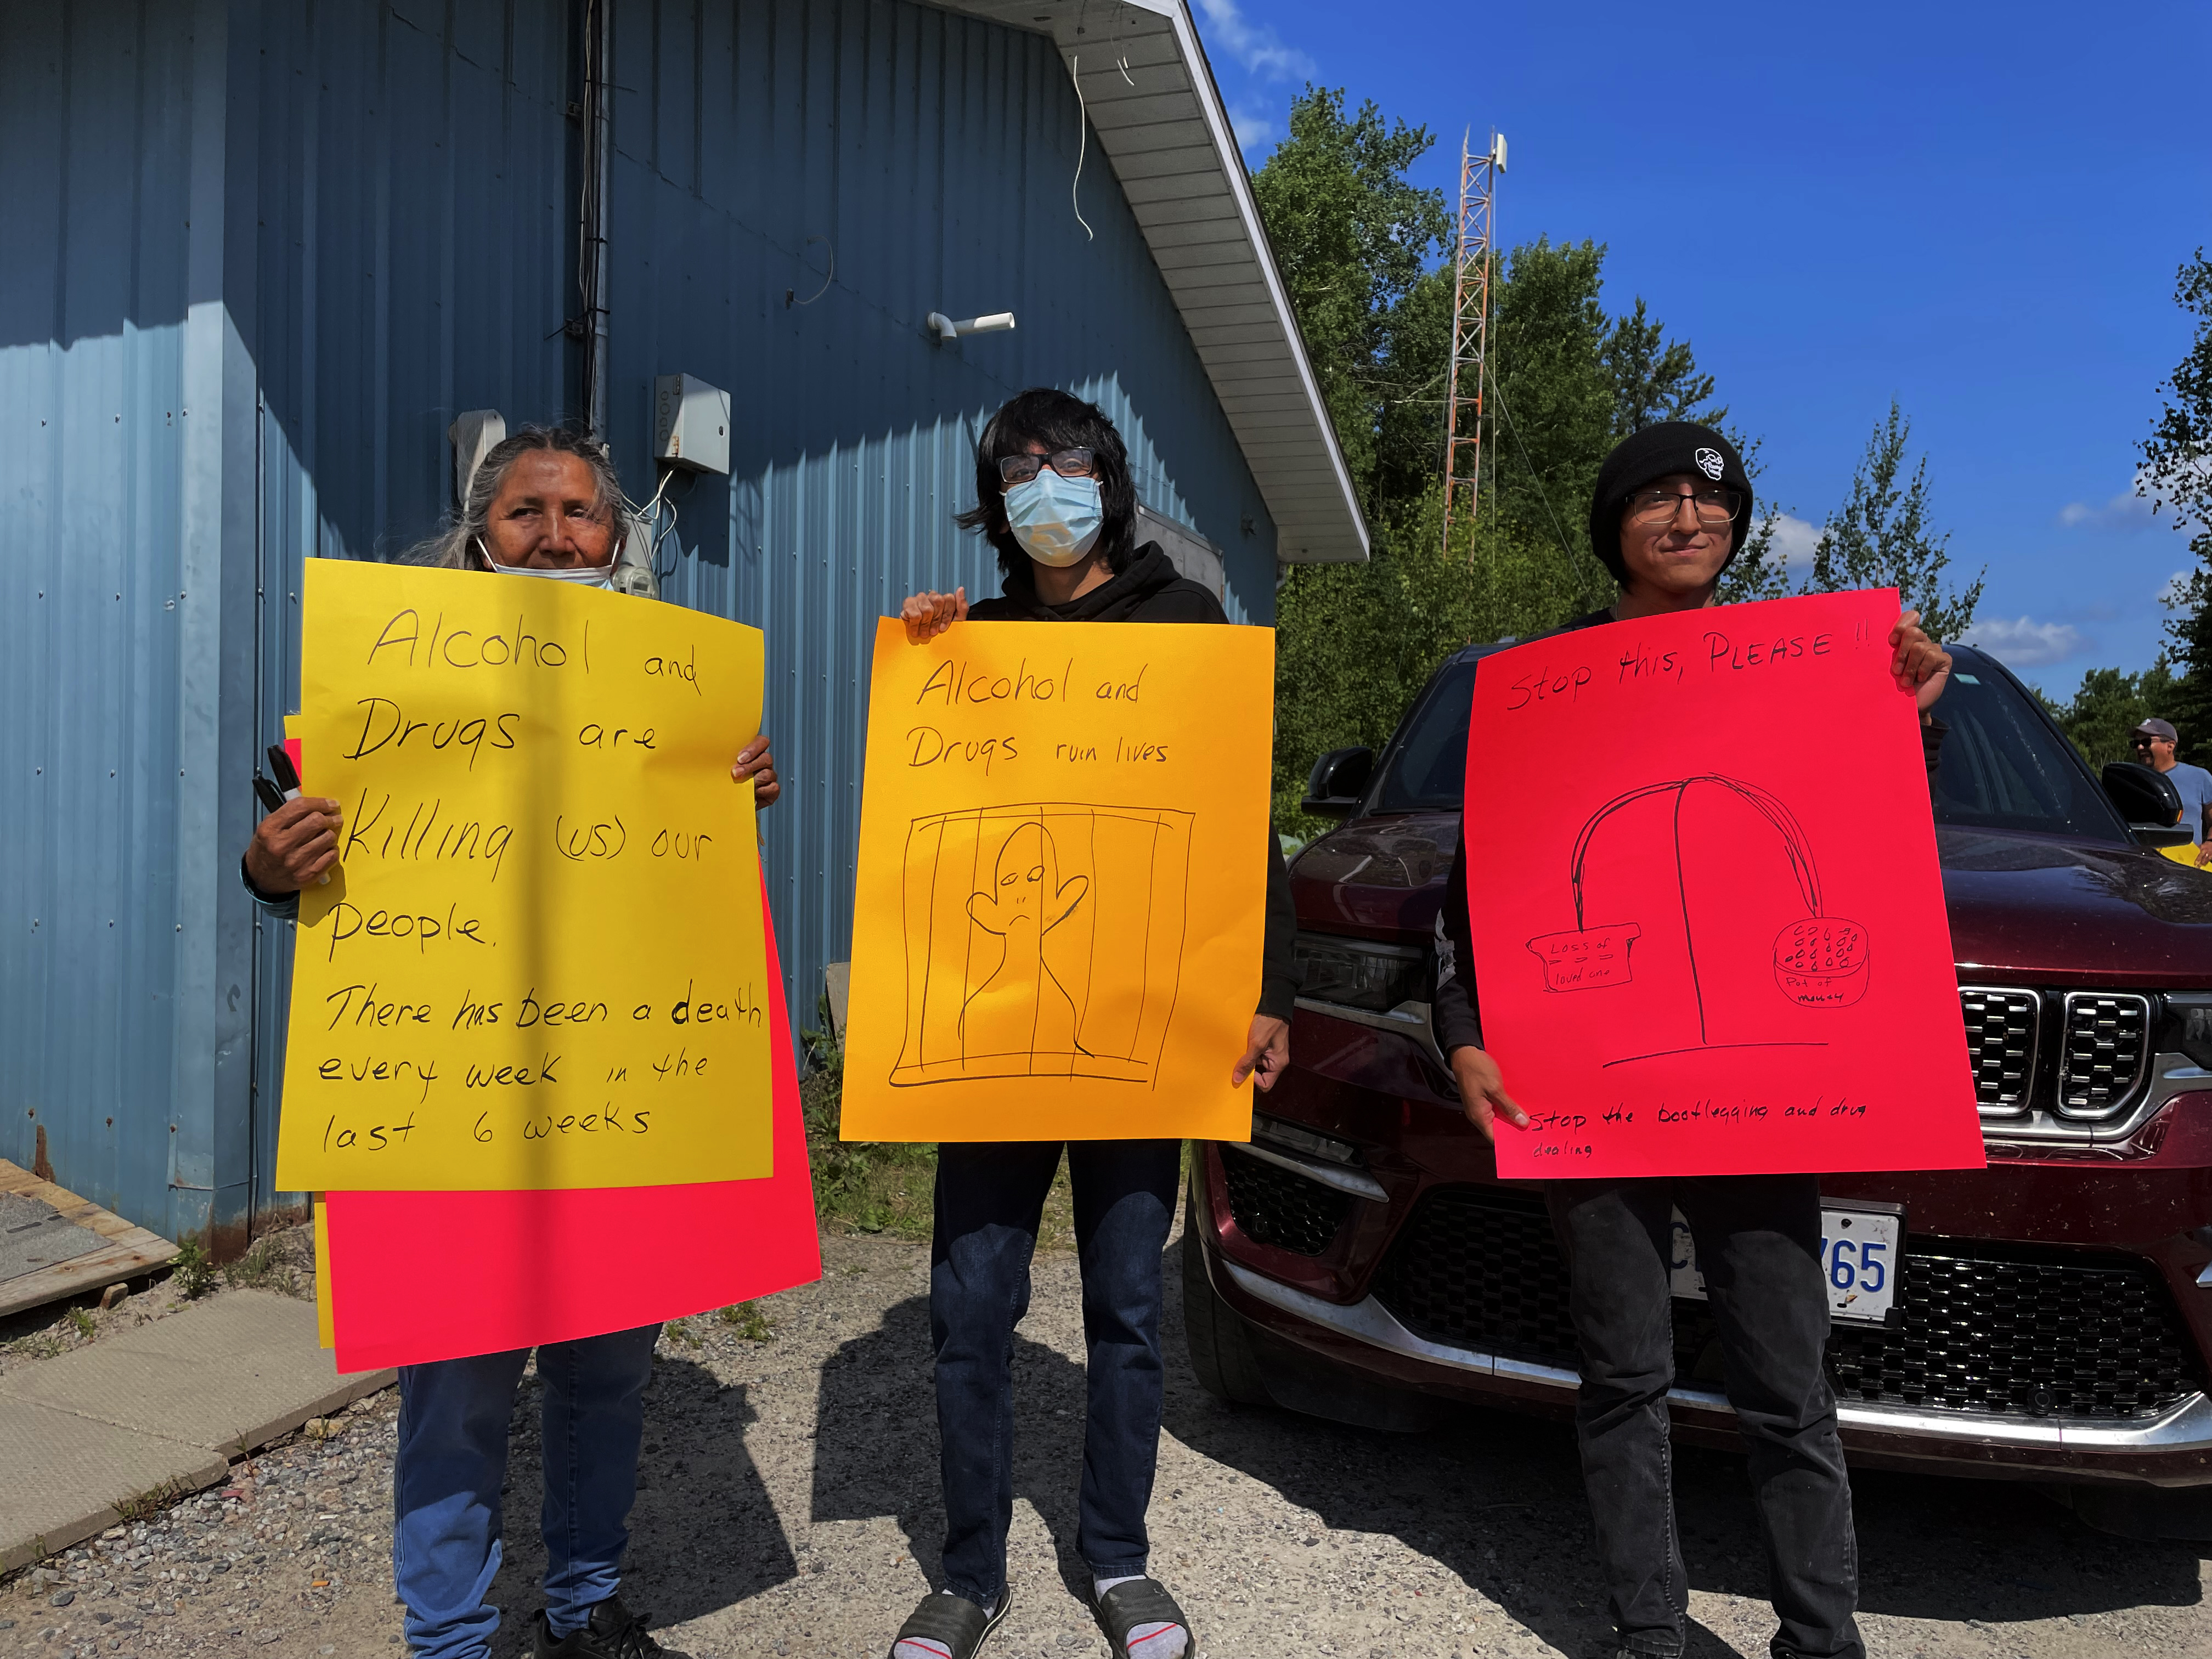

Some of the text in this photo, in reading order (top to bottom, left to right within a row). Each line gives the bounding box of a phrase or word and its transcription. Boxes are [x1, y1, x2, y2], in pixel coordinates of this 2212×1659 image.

[367, 608, 702, 696] Alcohol and
[1506, 666, 1592, 711] Stop
[1619, 642, 1685, 685] this,
[1703, 631, 1832, 673] PLEASE
[916, 657, 1148, 706] Alcohol and
[342, 697, 657, 771] Drugs are
[907, 726, 1169, 777] Drugs ruin lives
[343, 787, 713, 882] Killing (us) our
[326, 979, 763, 1031] There has been a death
[1786, 977, 1832, 987] Pot of
[318, 1047, 709, 1104] every week in the
[323, 1101, 651, 1153] last 6 weeks
[1529, 1109, 1587, 1135] Stop
[1602, 1102, 1633, 1125] the
[1658, 1099, 1768, 1125] bootlegging
[1785, 1096, 1823, 1117] and
[1533, 1140, 1592, 1159] dealing
